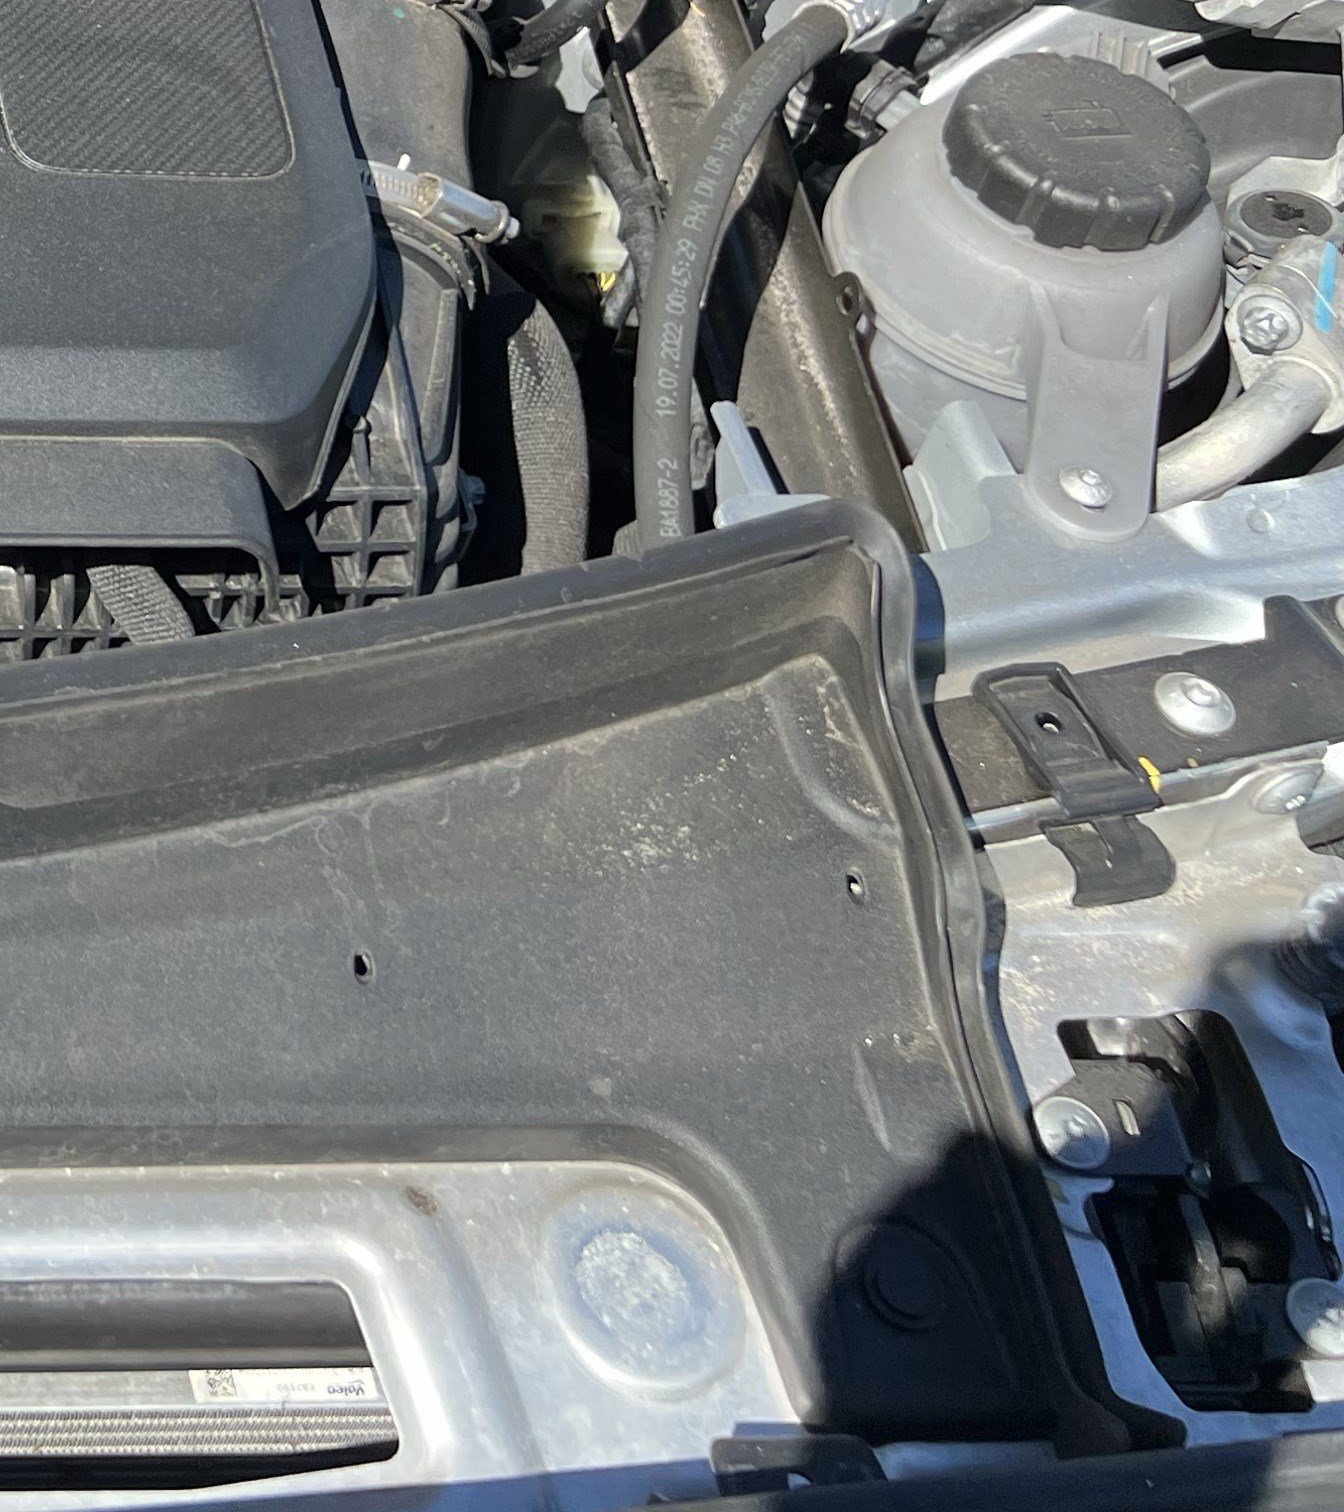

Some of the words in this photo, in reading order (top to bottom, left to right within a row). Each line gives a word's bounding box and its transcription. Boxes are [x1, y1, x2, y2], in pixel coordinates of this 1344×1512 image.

[664, 237, 699, 316] 00:45:29
[654, 321, 684, 416] 19.07.2022
[326, 1381, 366, 1397] Valeo
